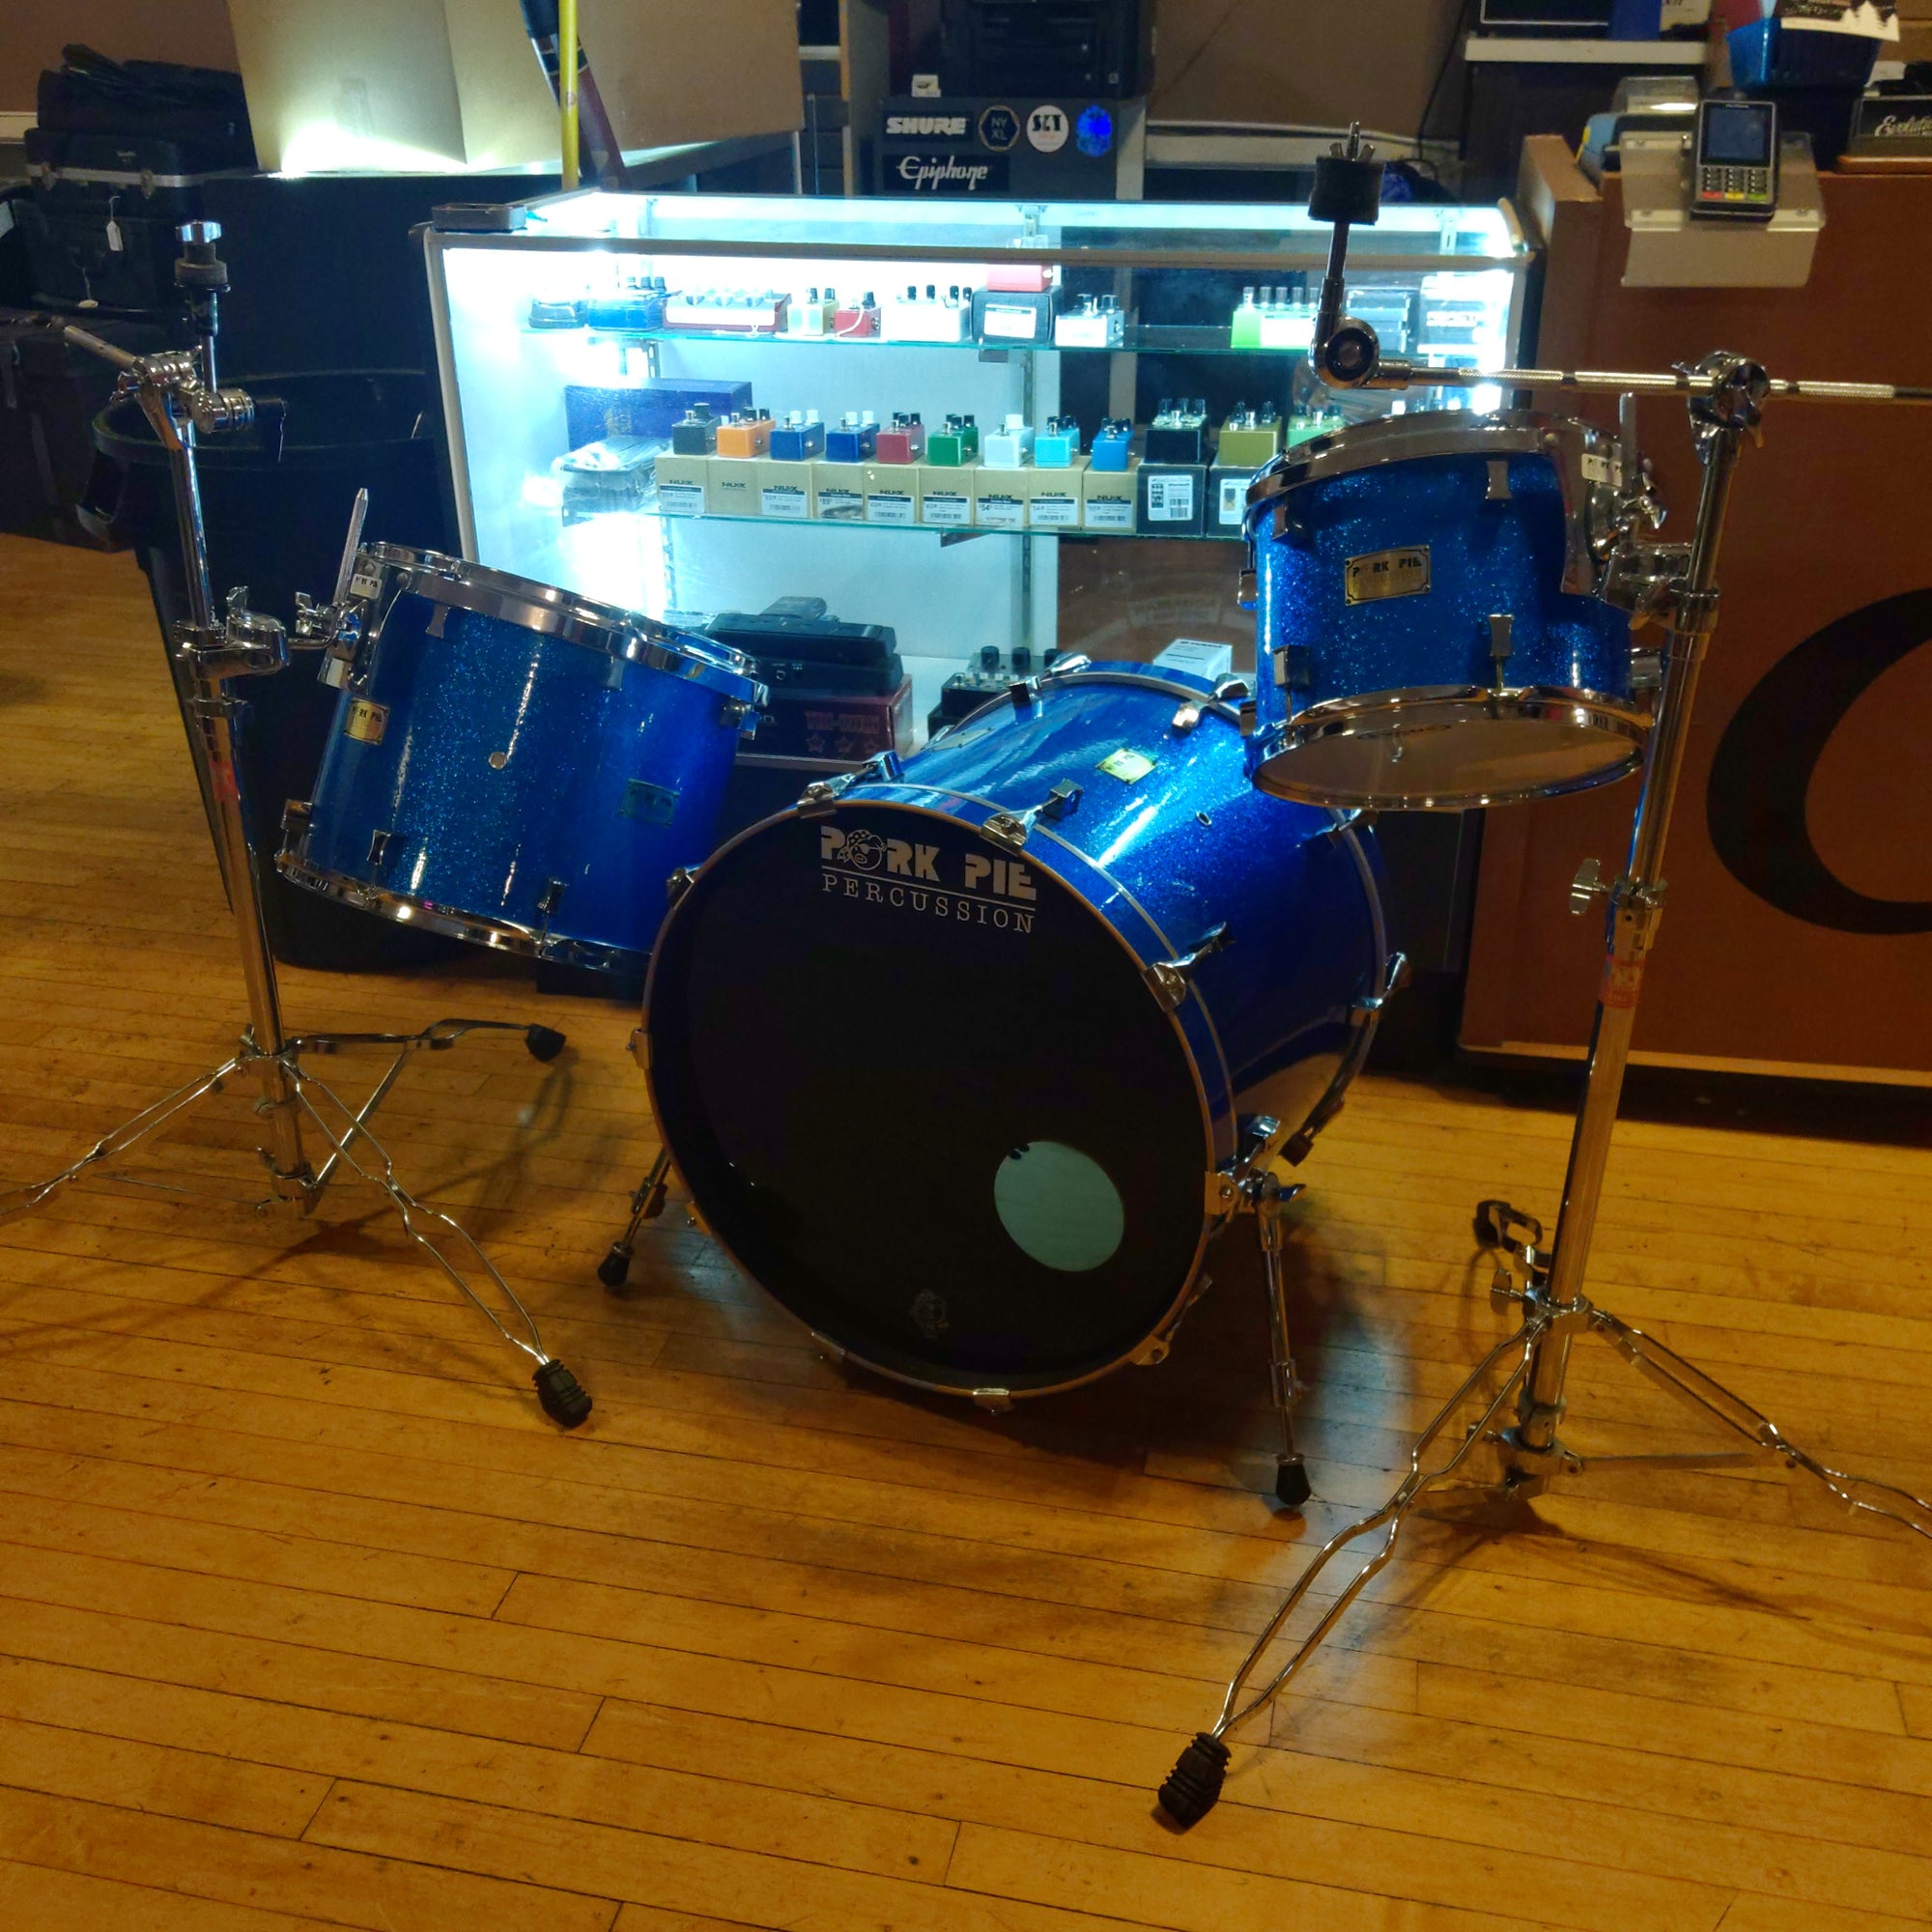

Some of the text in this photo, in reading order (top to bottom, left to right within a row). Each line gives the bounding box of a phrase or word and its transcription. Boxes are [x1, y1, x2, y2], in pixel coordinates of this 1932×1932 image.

[886, 116, 967, 136] SHURE
[896, 155, 989, 191] Epiphone
[964, 853, 1037, 901] PIE
[822, 873, 1035, 934] PERCUSSION
